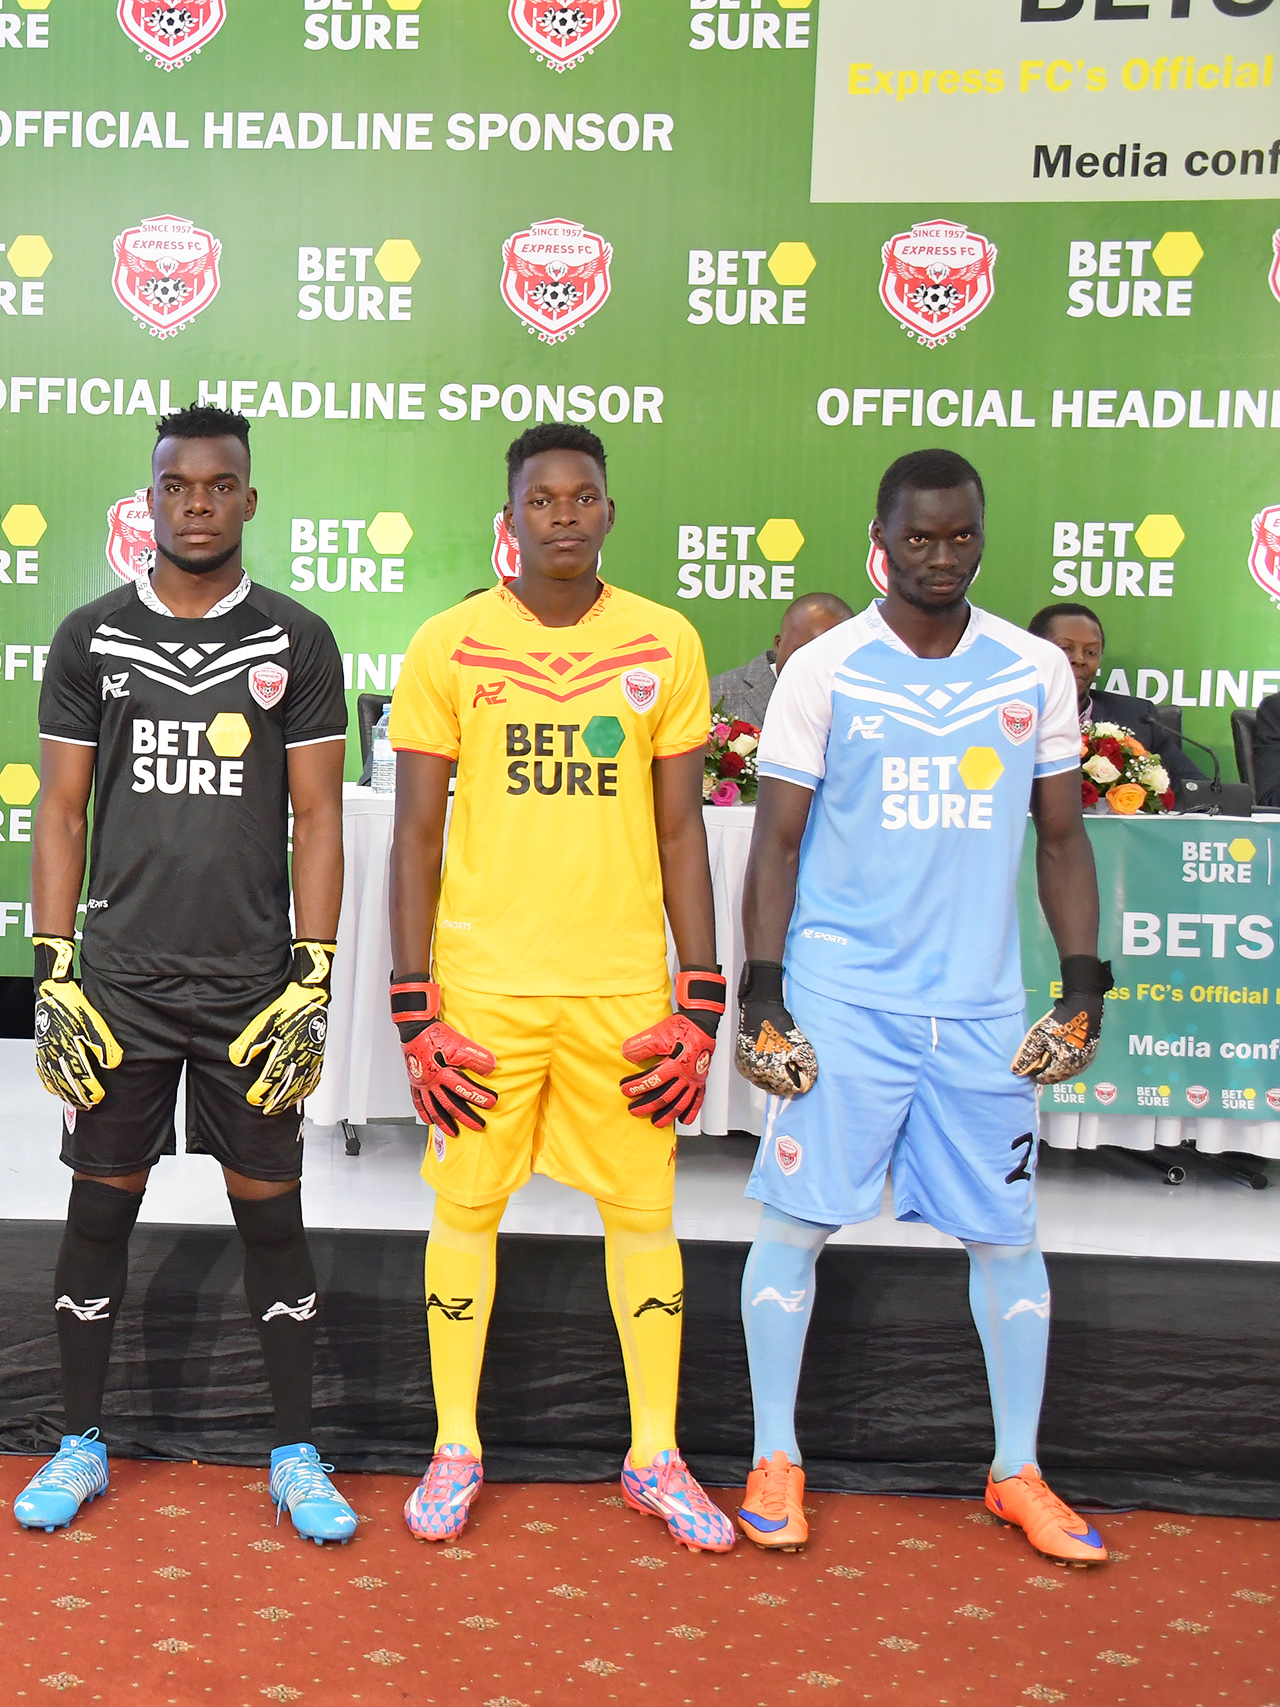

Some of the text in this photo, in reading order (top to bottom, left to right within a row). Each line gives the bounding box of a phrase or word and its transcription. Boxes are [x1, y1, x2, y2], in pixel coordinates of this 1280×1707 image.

[304, 14, 419, 50] SURE
[689, 13, 810, 49] SURE
[849, 54, 1273, 101] Express FC's Official
[204, 112, 433, 150] HEADLINE
[446, 113, 673, 151] SPONSOR
[1033, 143, 1167, 178] Media
[132, 240, 202, 250] EXPRESS FC
[142, 225, 191, 235] SINCE 1957
[531, 227, 581, 237] SINCE 1957
[912, 229, 964, 238] SINCE 1957
[298, 247, 373, 281] BET
[521, 244, 592, 254] EXPRESS FC
[902, 246, 974, 256] EXPRESS FC
[1069, 241, 1150, 276] BET
[688, 250, 766, 285] BET
[297, 285, 412, 320] SURE
[687, 288, 806, 325] SURE
[1067, 280, 1192, 317] SURE
[198, 380, 425, 419] HEADLINE
[438, 384, 663, 423] SPONSOR
[817, 388, 1035, 427] OFFICIAL
[291, 519, 365, 553] BET
[678, 526, 755, 560] BET
[1053, 522, 1134, 557] BET
[290, 556, 404, 592] SURE
[677, 563, 794, 599] SURE
[1051, 560, 1174, 596] SURE
[1090, 669, 1280, 708] ADLINE
[133, 719, 206, 755] BET
[507, 724, 579, 757] BET
[132, 757, 243, 796] SURE
[507, 761, 617, 796] SURE
[882, 757, 956, 792] BET
[881, 794, 993, 830] SURE
[1183, 842, 1227, 861] BET
[1183, 862, 1251, 883] SURE
[814, 931, 848, 946] SPORTS
[1123, 912, 1274, 959] BETS
[1136, 983, 1184, 1002] FC's
[1190, 984, 1269, 1005] Official
[1129, 1035, 1211, 1057] Media
[1053, 1084, 1074, 1094] BET
[1054, 1094, 1085, 1103] SURE
[1137, 1087, 1158, 1097] BET
[1138, 1097, 1169, 1106] SURE
[1222, 1090, 1243, 1099] BET
[1223, 1100, 1254, 1109] SURE
